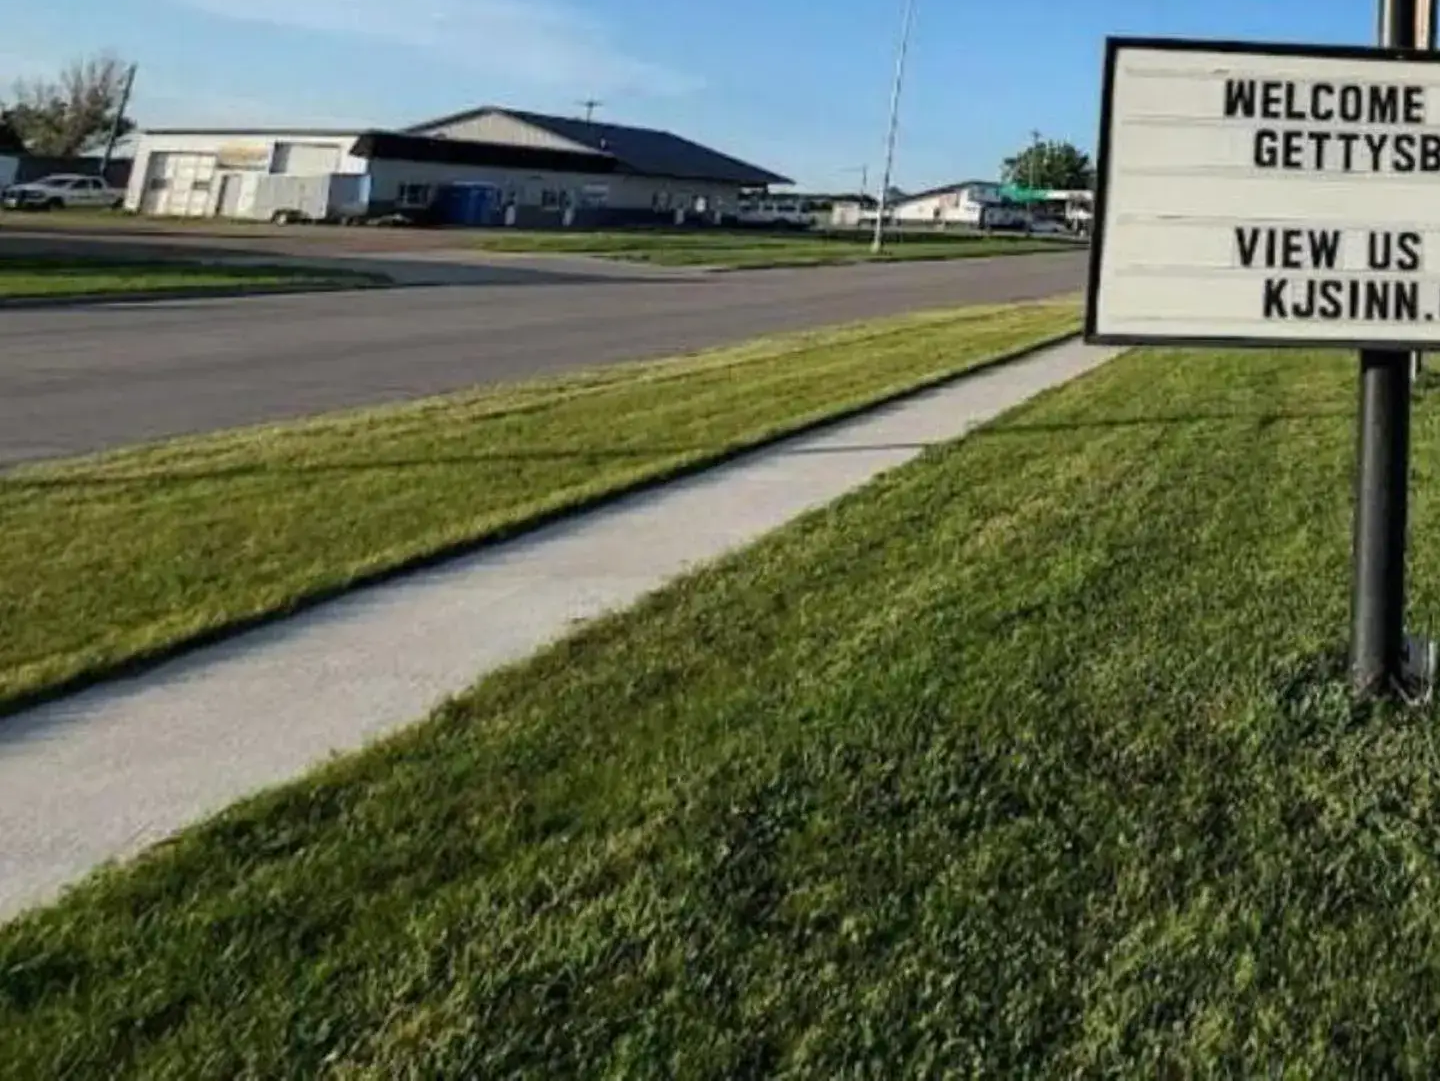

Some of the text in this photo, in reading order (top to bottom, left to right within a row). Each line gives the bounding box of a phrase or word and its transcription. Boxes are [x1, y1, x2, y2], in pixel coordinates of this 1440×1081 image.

[1224, 77, 1425, 124] WELCOME
[1234, 226, 1341, 270] VIEW
[1367, 231, 1422, 271] US
